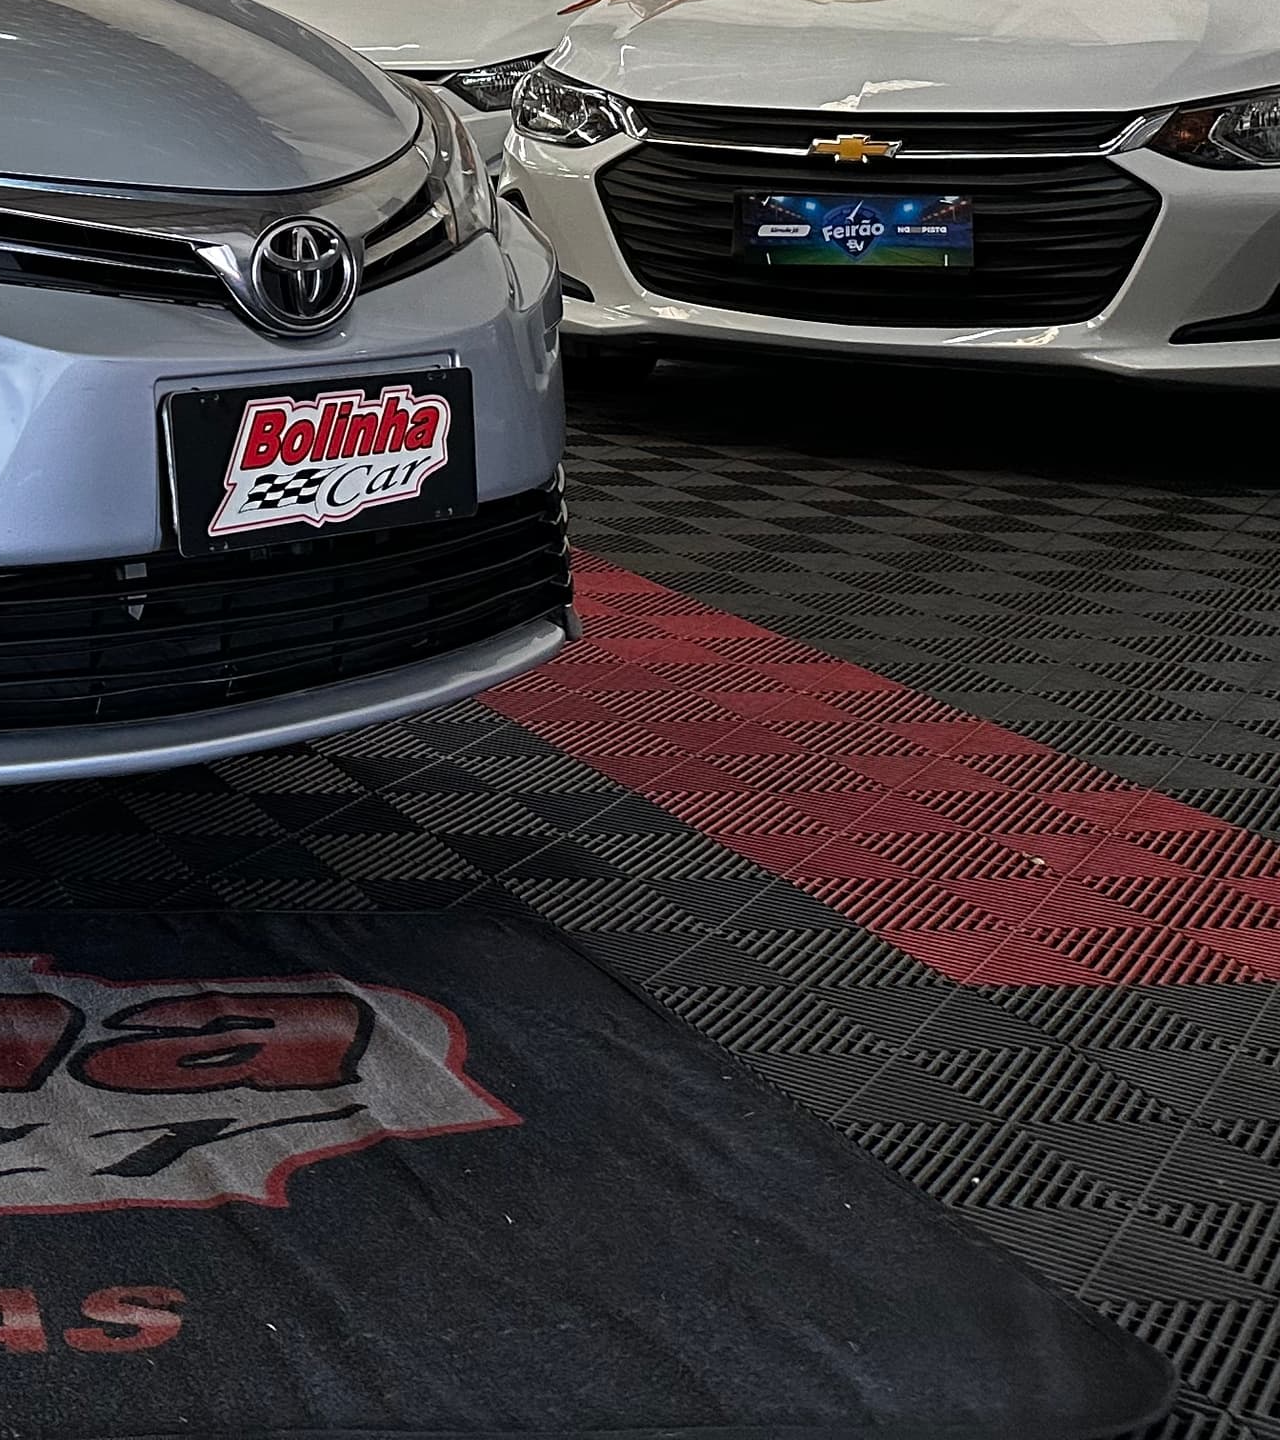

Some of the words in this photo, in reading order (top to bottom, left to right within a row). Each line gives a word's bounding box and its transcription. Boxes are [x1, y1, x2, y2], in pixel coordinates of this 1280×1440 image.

[822, 219, 885, 242] Feirão
[240, 398, 441, 471] Bolinha
[326, 455, 431, 507] Car
